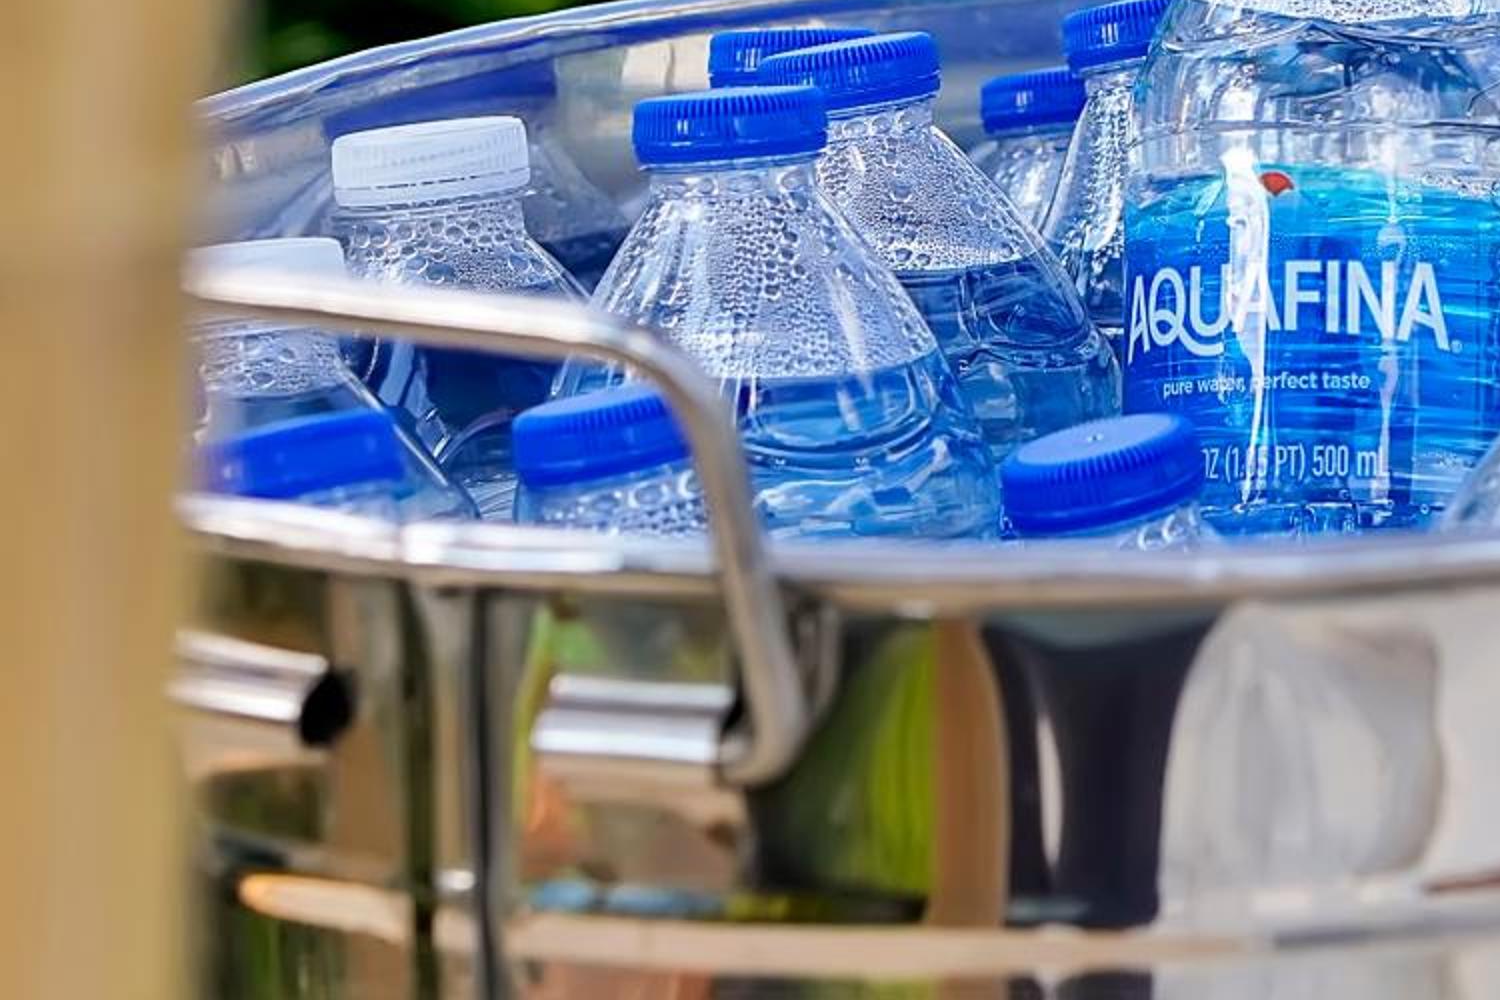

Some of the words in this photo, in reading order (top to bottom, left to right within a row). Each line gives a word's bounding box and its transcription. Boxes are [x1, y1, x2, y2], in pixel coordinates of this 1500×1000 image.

[1127, 259, 1451, 366] AQUAFINA
[1163, 377, 1193, 398] pure
[1322, 367, 1371, 390] taste
[1274, 443, 1305, 481] PT)
[1312, 445, 1349, 477] 500
